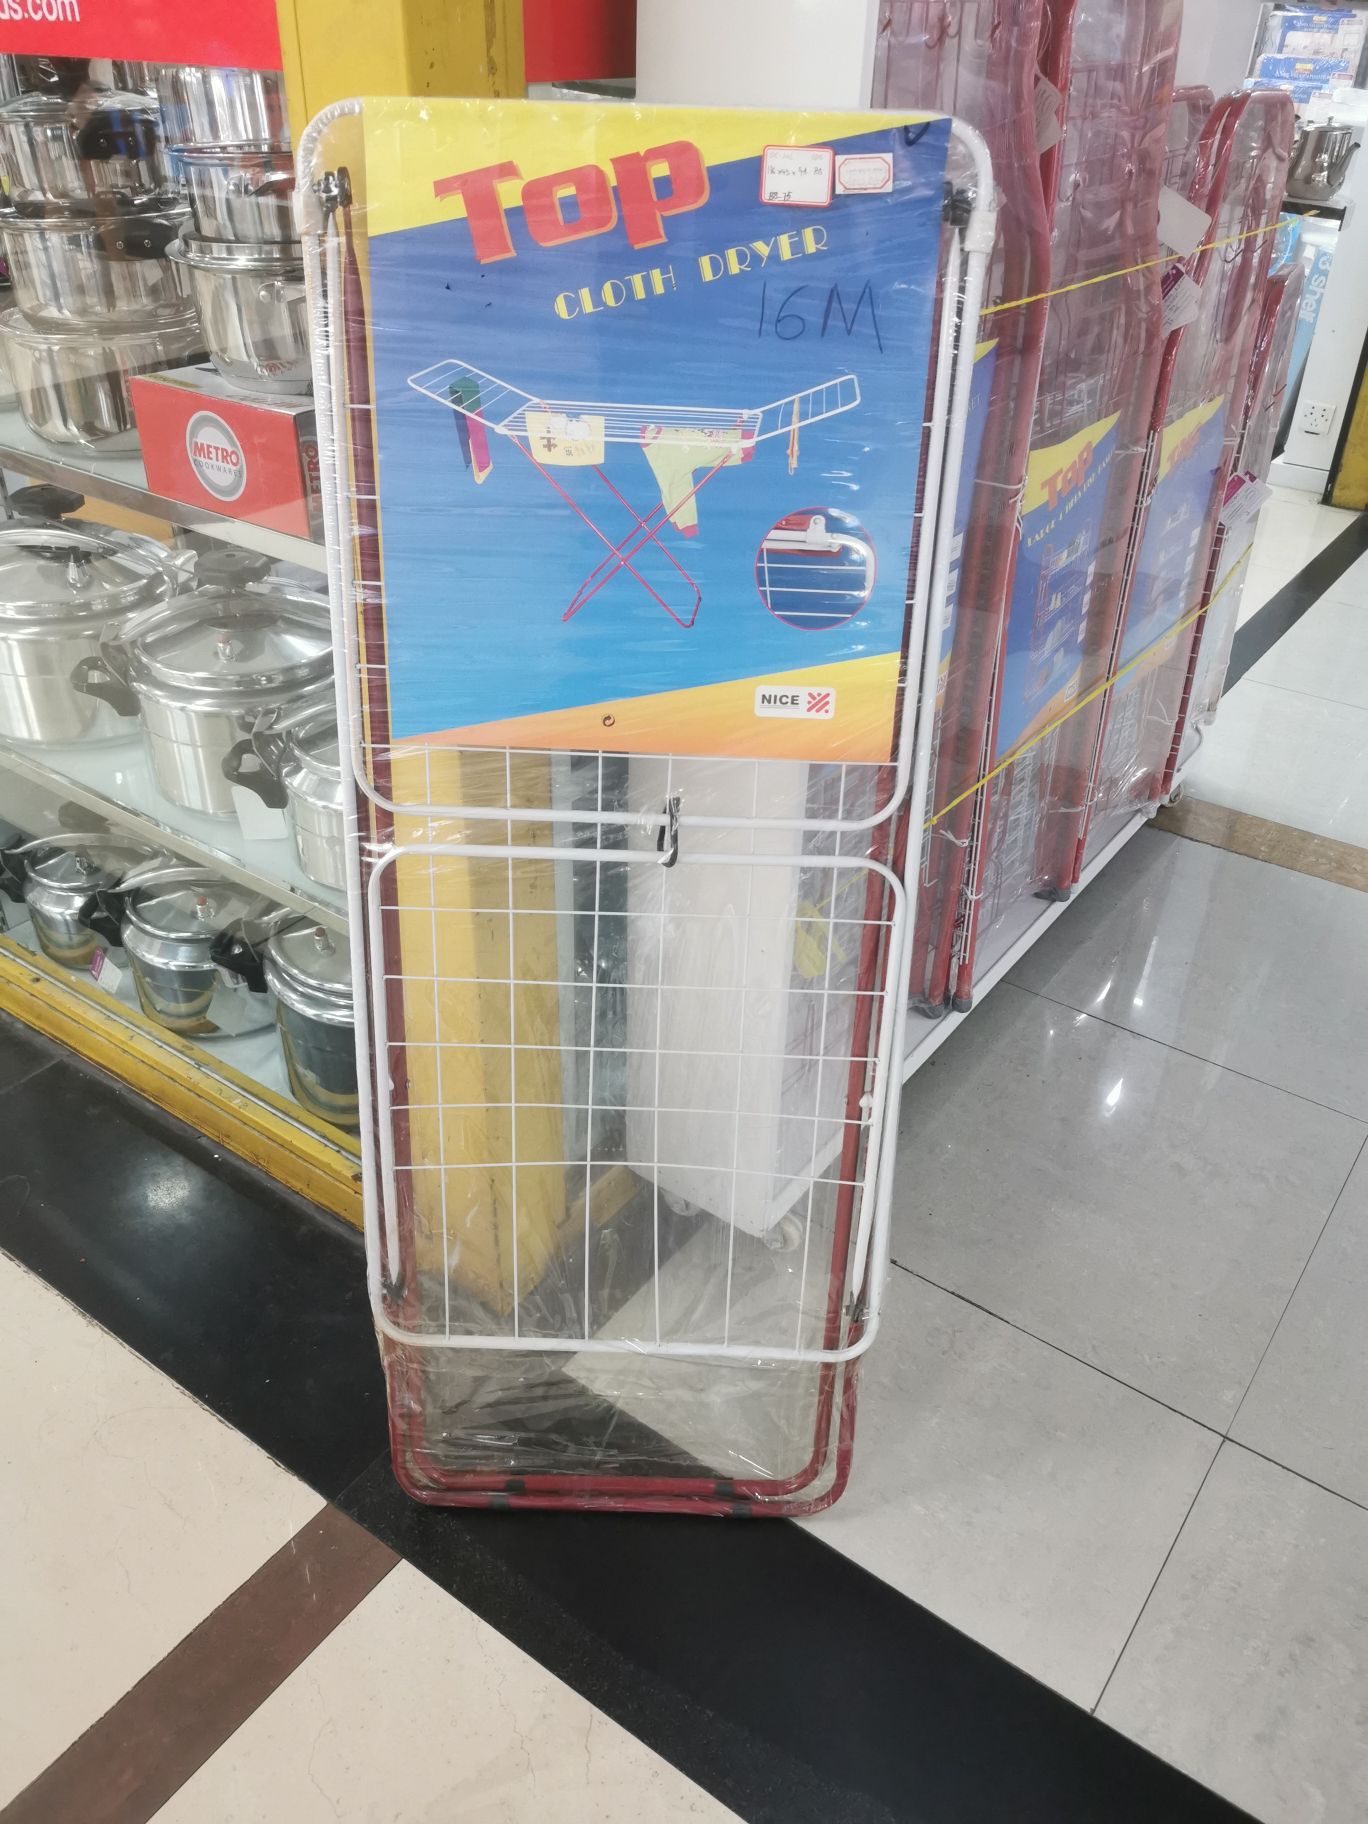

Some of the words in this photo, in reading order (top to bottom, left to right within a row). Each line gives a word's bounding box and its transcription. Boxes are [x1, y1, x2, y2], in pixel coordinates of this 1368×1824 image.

[554, 264, 678, 320] CLOTH
[698, 225, 829, 282] DRYER
[192, 440, 240, 467] METRO
[761, 693, 800, 706] NICE
